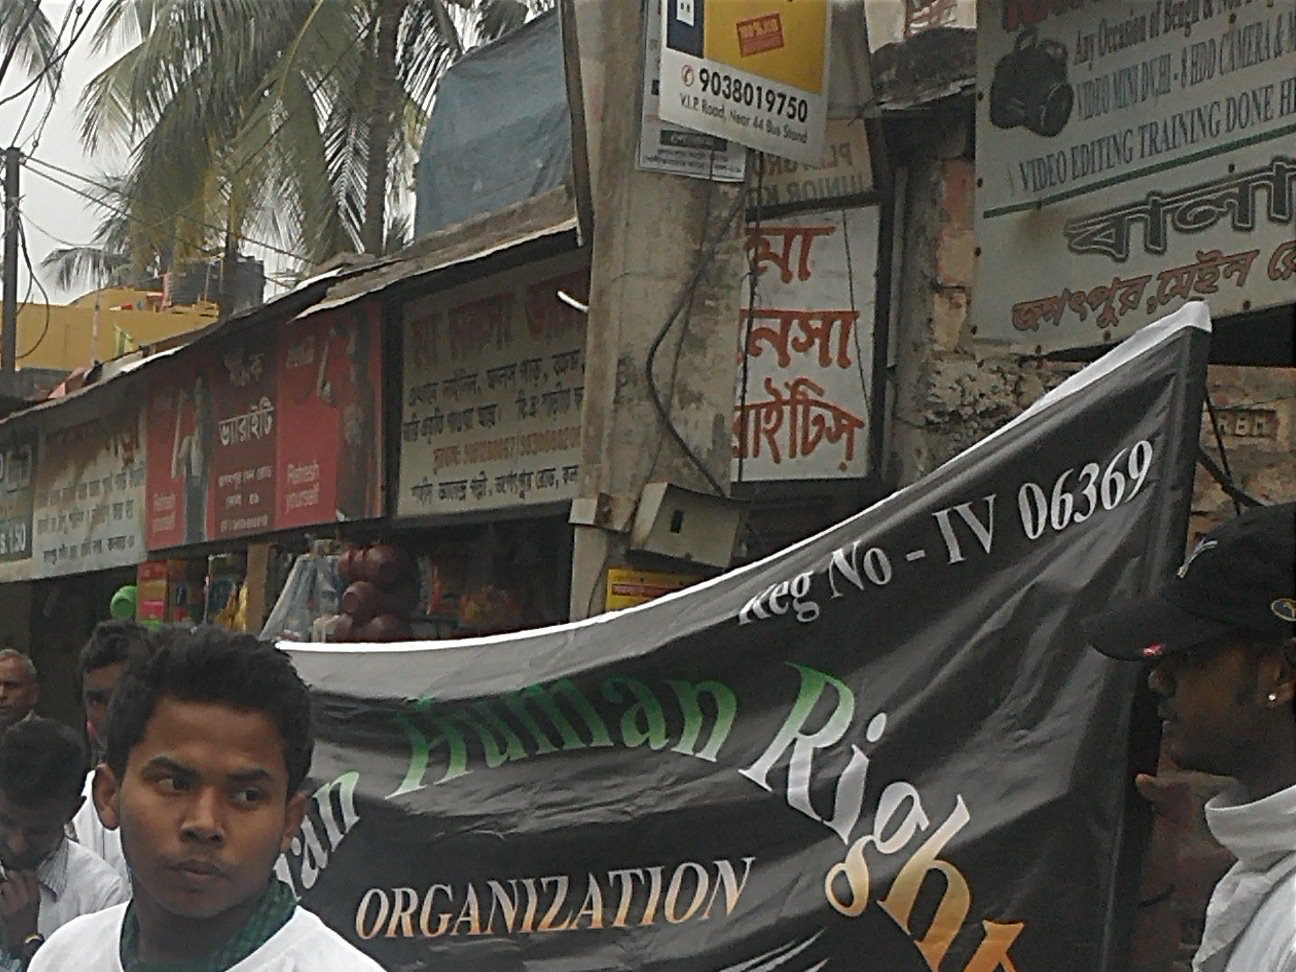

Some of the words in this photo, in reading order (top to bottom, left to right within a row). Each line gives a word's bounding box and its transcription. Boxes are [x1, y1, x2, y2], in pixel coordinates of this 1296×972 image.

[699, 68, 808, 123] 9038019750
[766, 121, 781, 136] Bus
[784, 124, 807, 144] Stand
[1019, 151, 1067, 194] VIDEO
[1070, 129, 1133, 180] EDITING
[1137, 100, 1221, 159] TRAINING
[1225, 84, 1274, 134] DONE
[744, 226, 836, 284] মা
[737, 308, 860, 369] নসা
[217, 397, 275, 446] ভ্যারাইটি
[829, 541, 893, 599] No
[906, 550, 925, 562] -
[932, 494, 998, 564] IV
[1018, 440, 1154, 541] 06369
[385, 676, 738, 799] Human
[354, 856, 757, 941] ORGANIZATION
